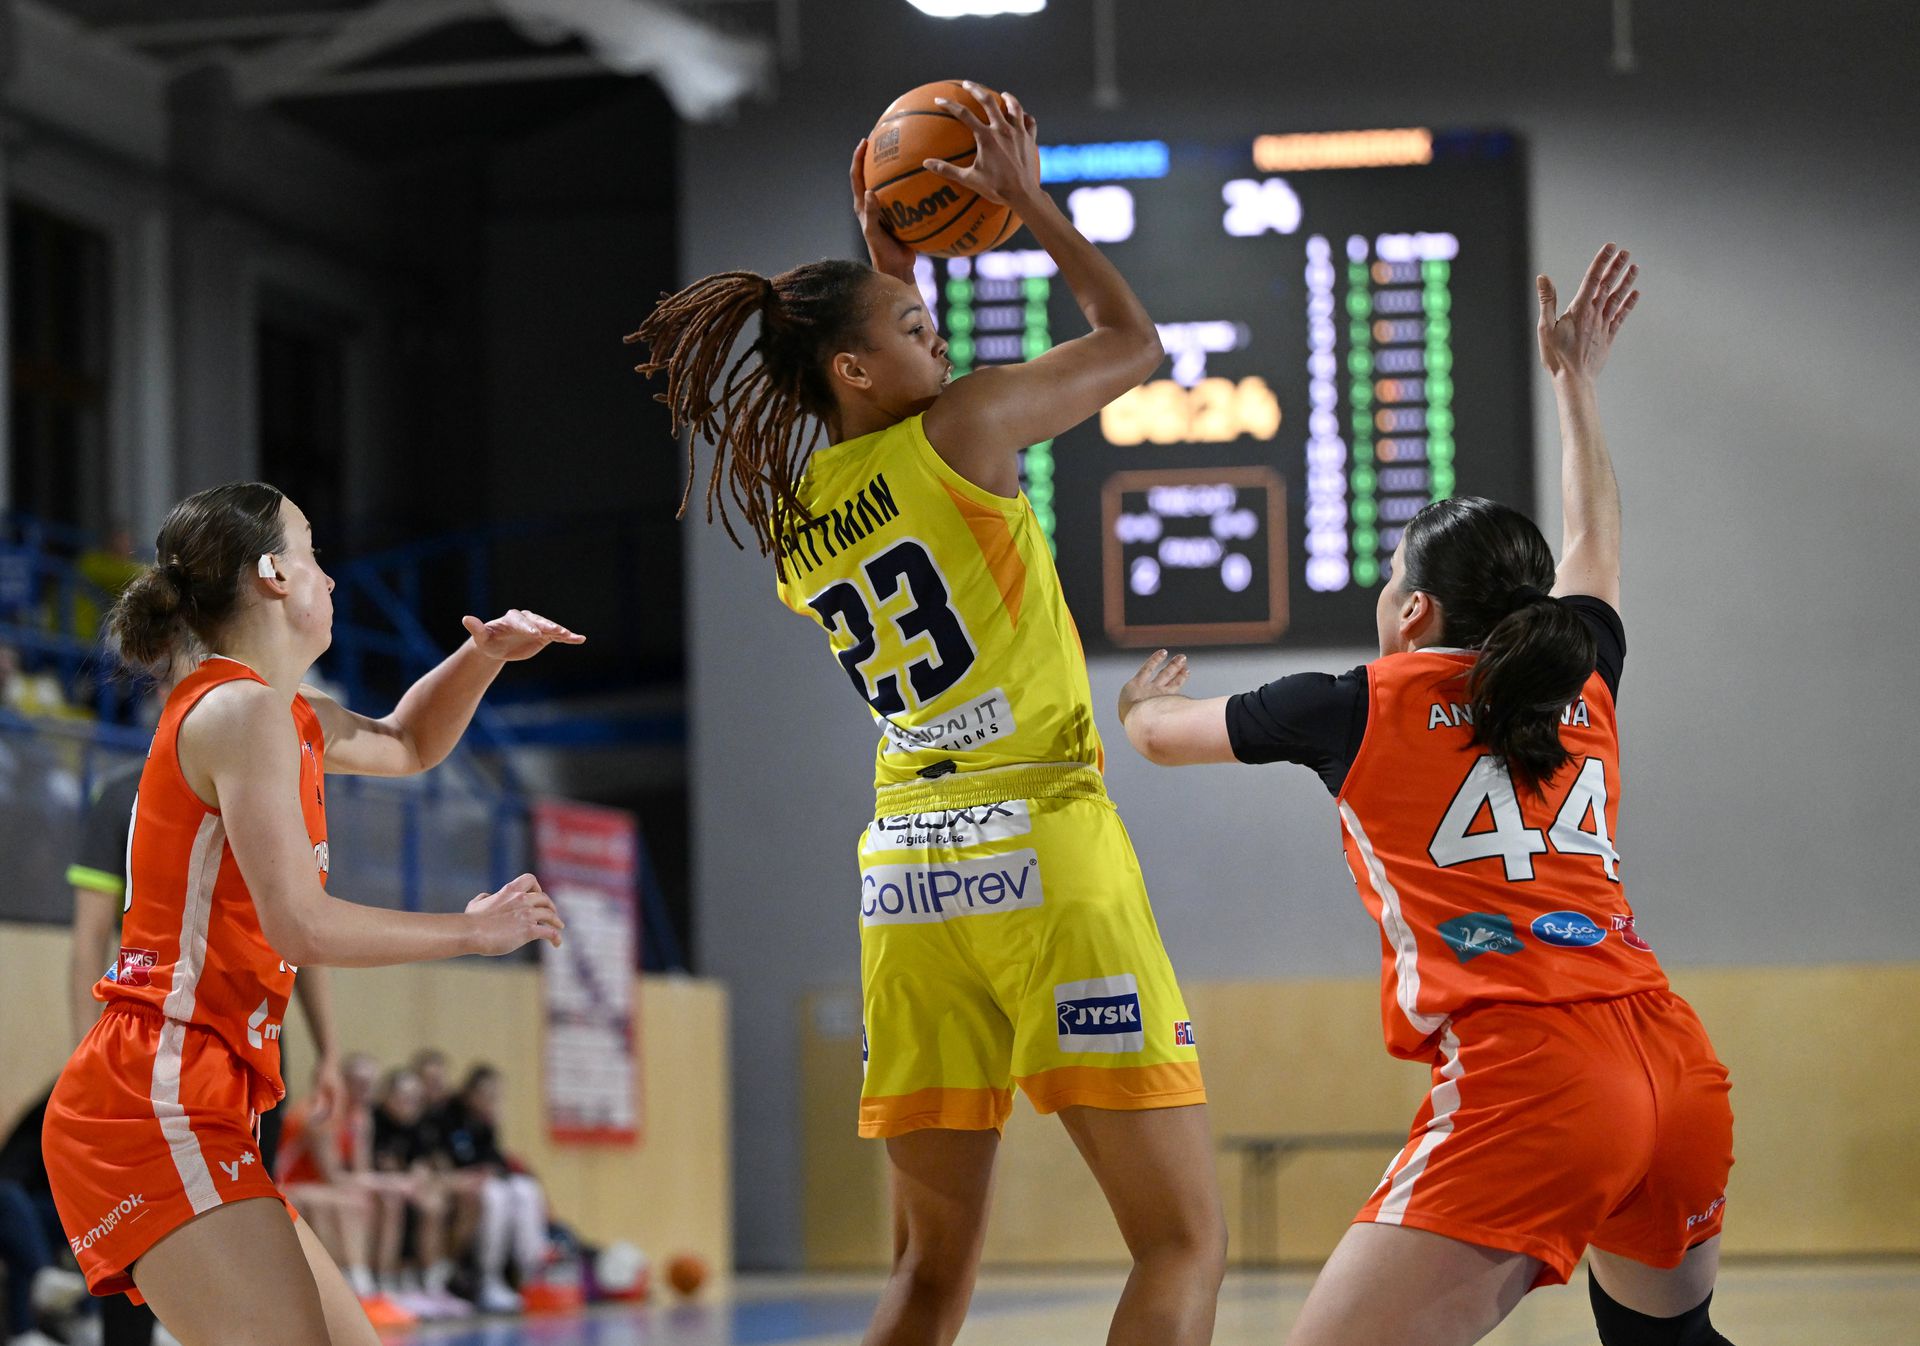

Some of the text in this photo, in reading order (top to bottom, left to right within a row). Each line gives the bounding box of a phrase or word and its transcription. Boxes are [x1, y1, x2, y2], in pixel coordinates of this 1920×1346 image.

[807, 537, 978, 718] 23
[896, 833, 964, 846] Digital Pulse
[1427, 755, 1622, 883] 44
[1075, 1003, 1138, 1025] JYSK
